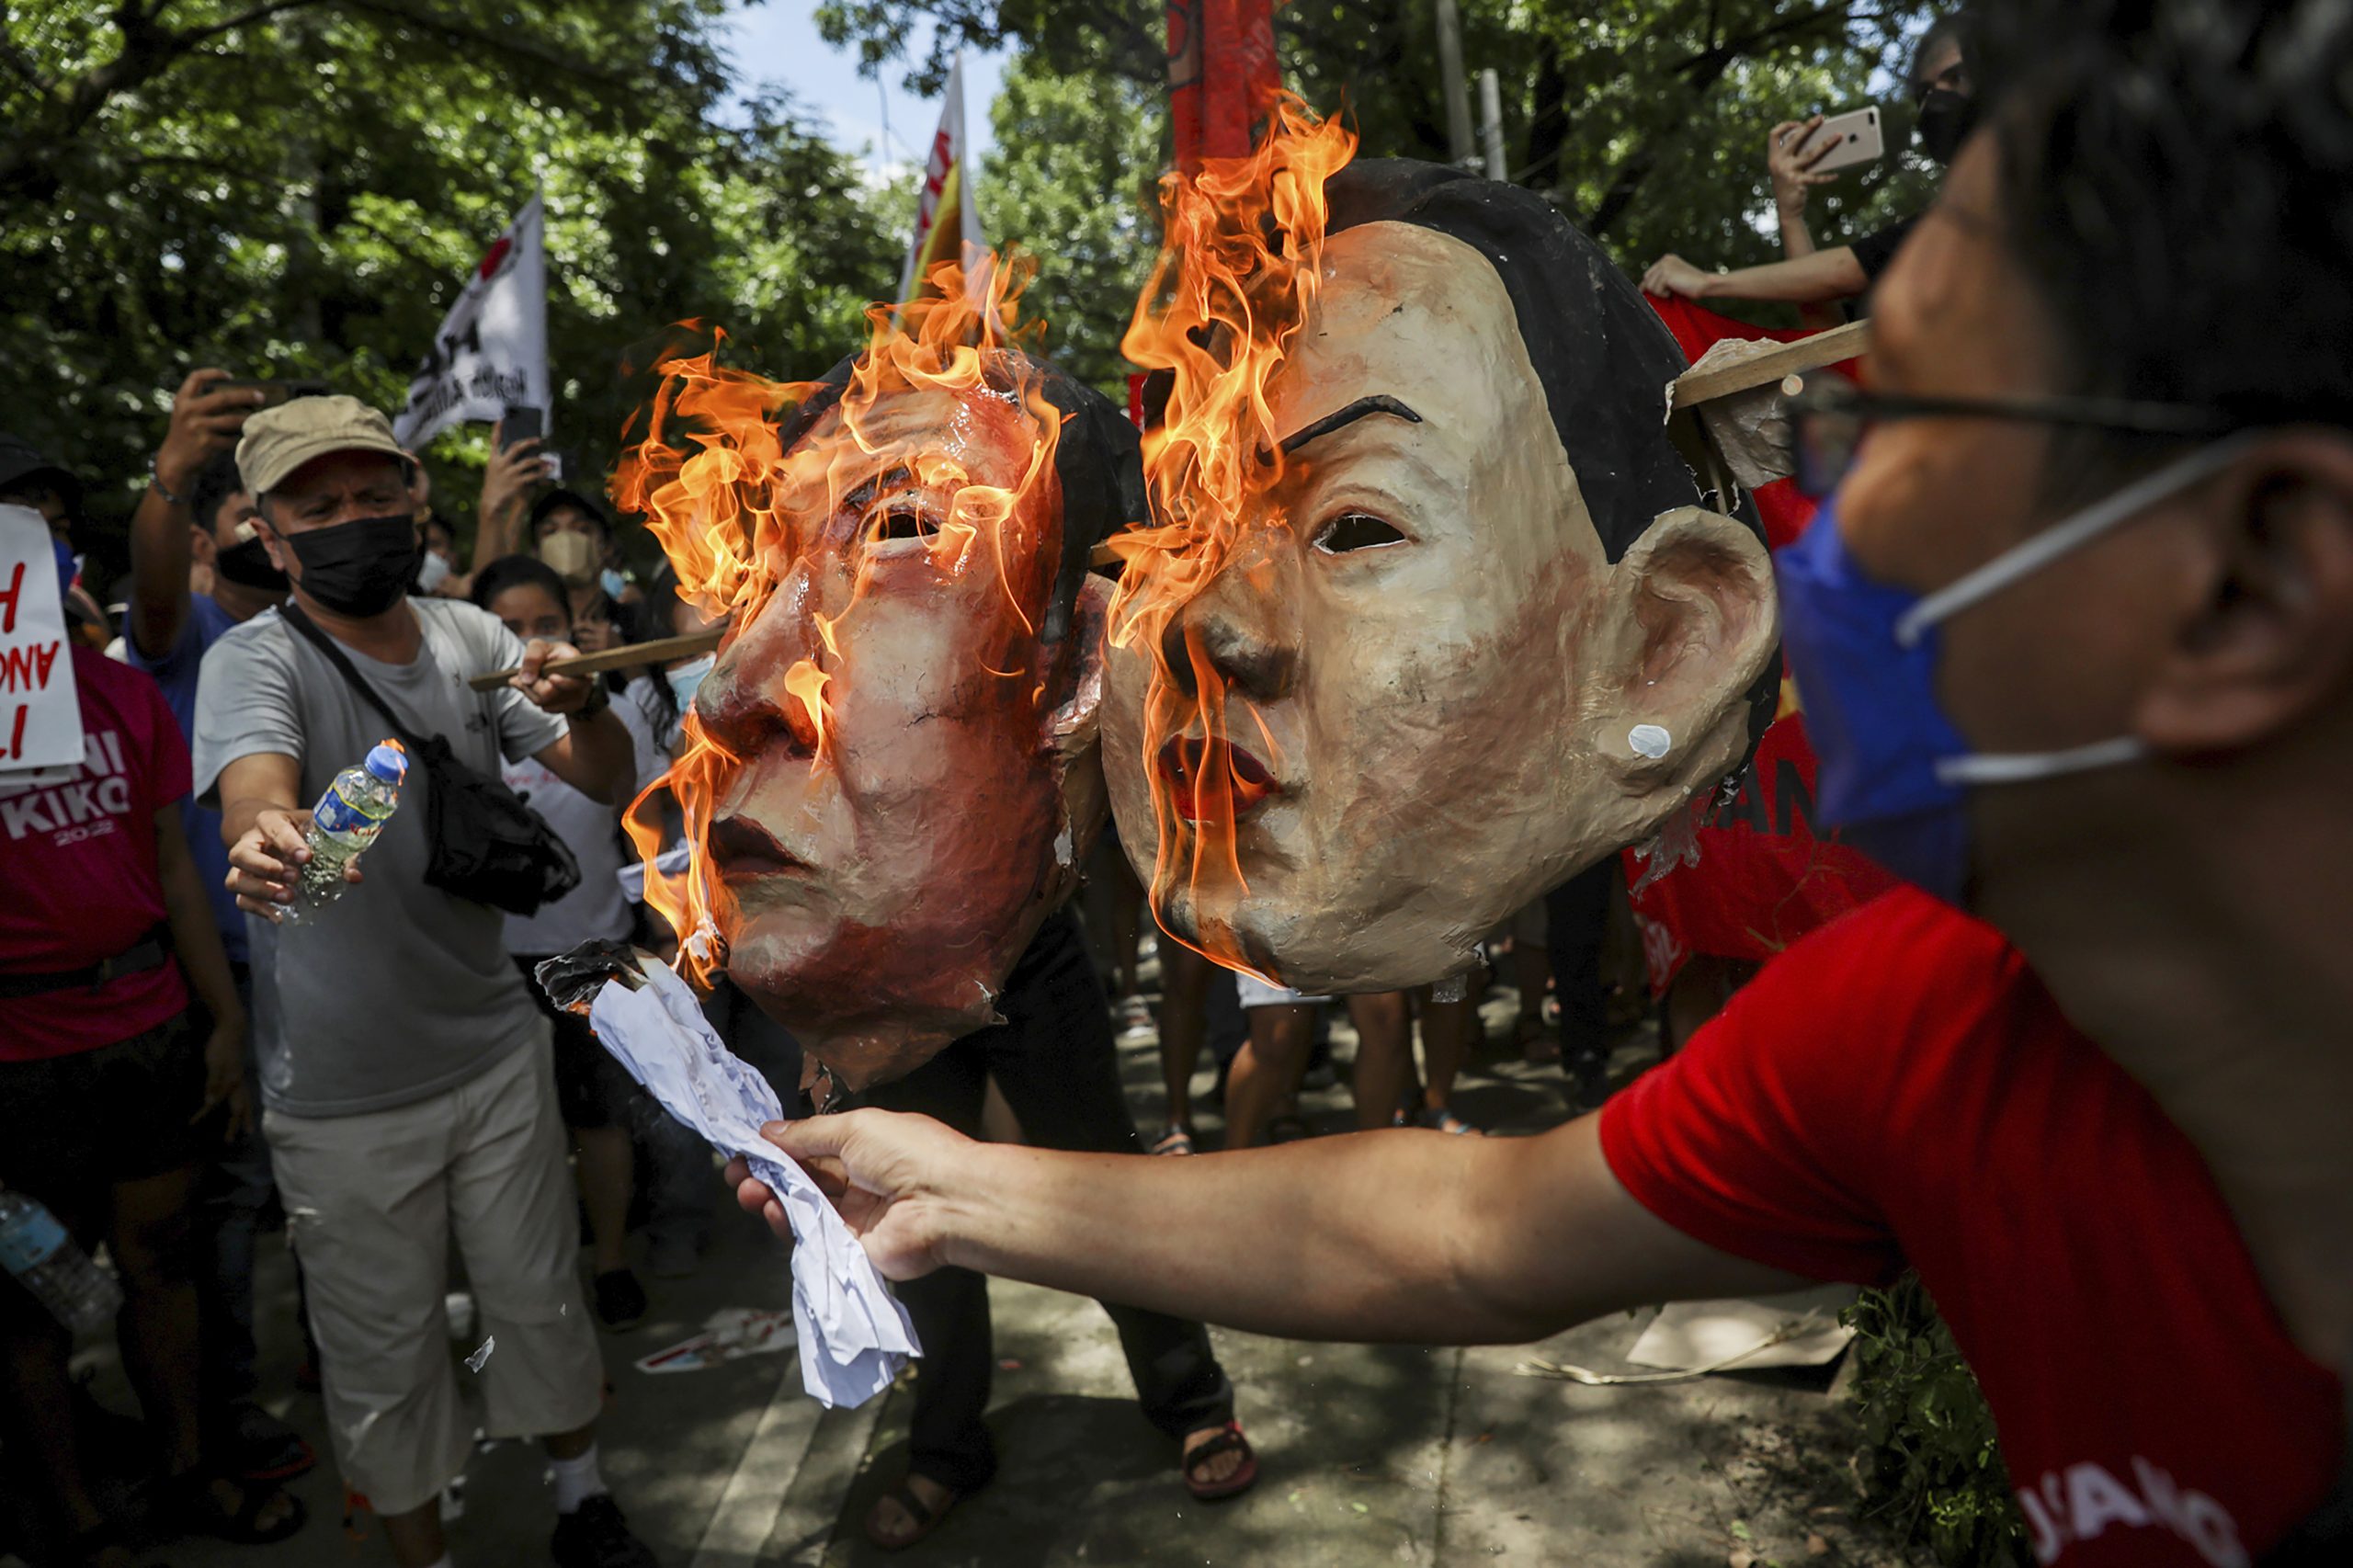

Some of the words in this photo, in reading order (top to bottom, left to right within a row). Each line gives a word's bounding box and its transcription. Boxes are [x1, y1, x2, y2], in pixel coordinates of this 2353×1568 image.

[0, 641, 60, 693] AN
[0, 777, 131, 840] KIKO
[1717, 758, 1850, 846] AN
